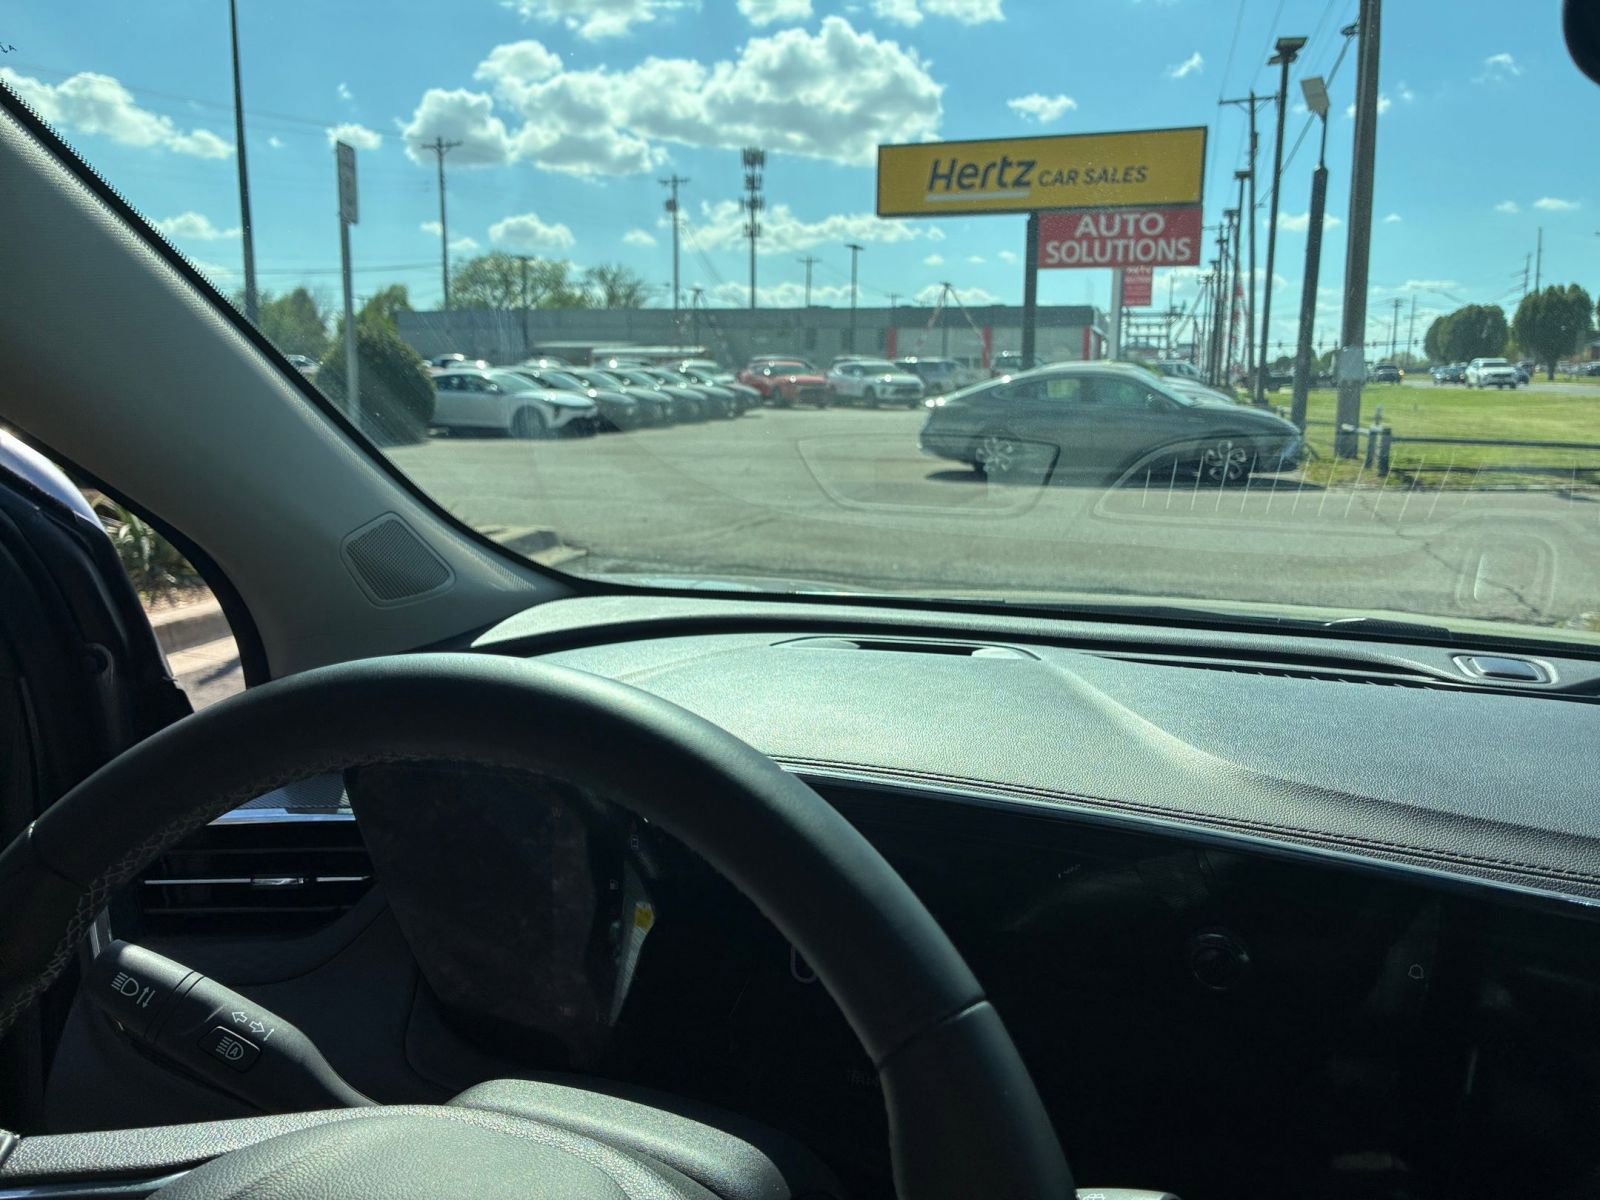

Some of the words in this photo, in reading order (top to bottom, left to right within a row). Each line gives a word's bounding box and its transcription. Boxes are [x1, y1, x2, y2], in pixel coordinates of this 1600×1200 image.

[928, 156, 1036, 191] Hertz
[1039, 169, 1078, 186] CAR
[1084, 165, 1148, 185] SALES
[1074, 212, 1165, 238] AUTO
[1045, 236, 1192, 264] SOLUTIONS
